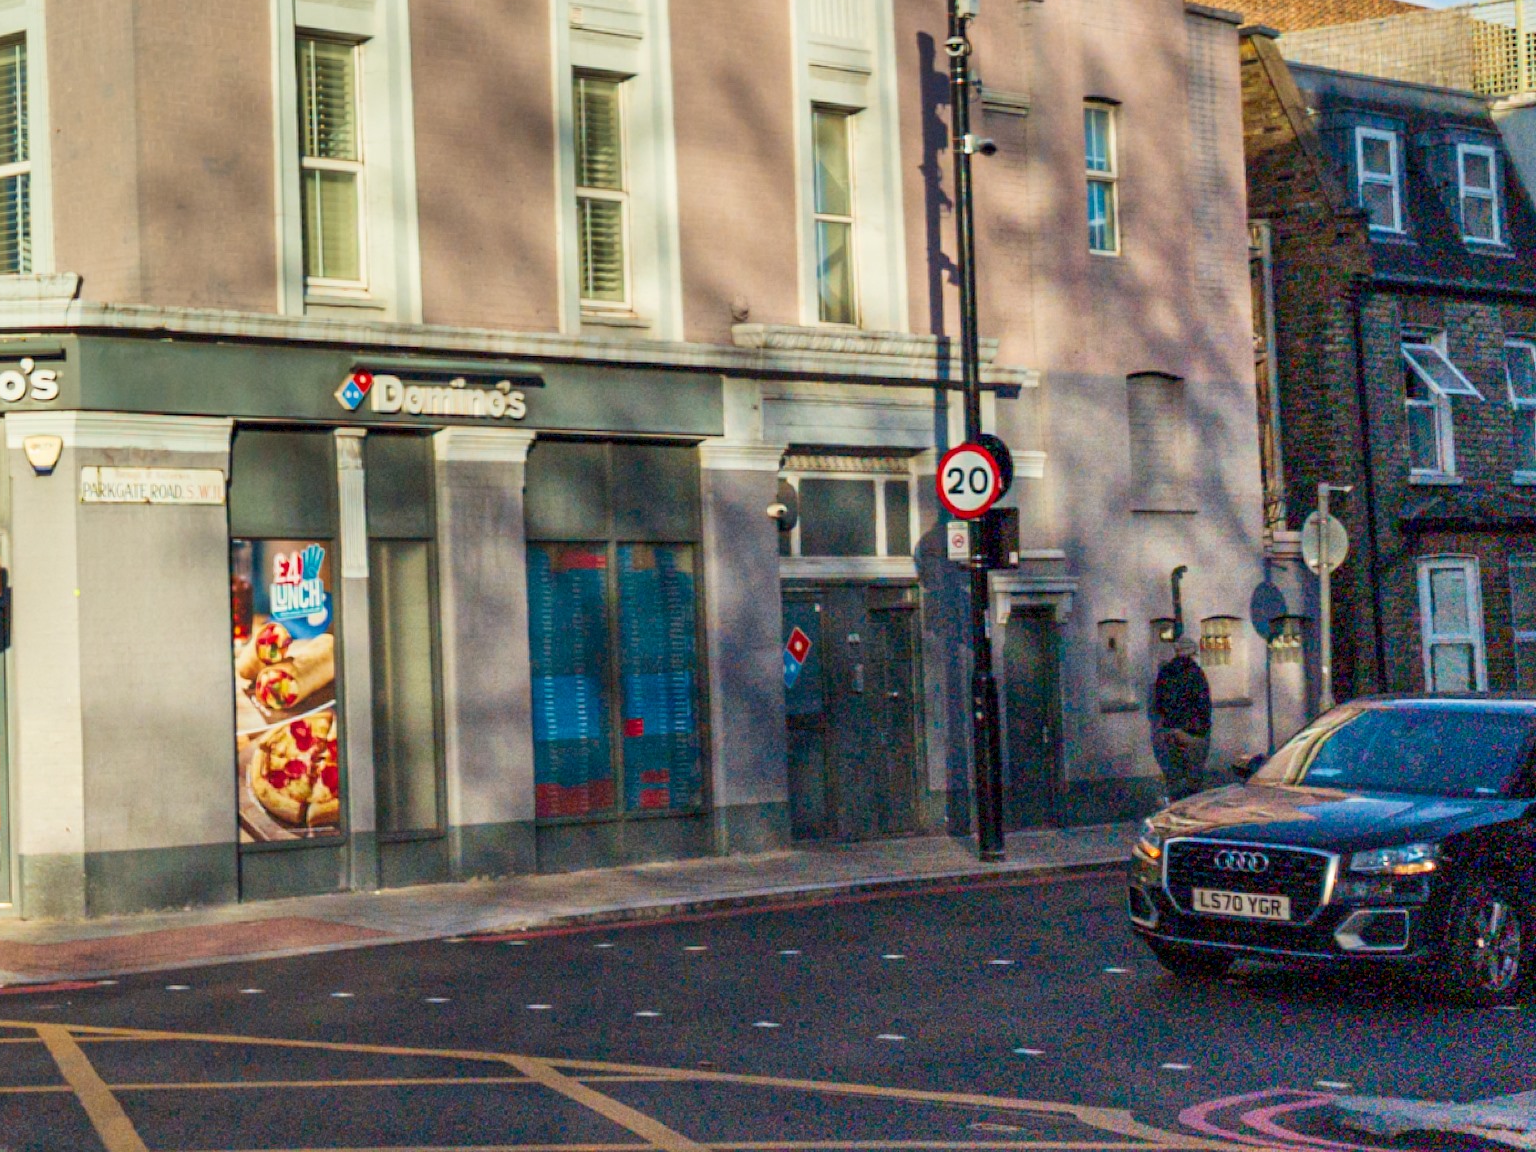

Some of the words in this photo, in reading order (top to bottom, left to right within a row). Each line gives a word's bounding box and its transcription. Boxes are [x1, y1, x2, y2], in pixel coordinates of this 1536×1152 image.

[371, 374, 526, 420] Domino's
[82, 481, 148, 499] PARKGATE
[947, 466, 988, 494] 20
[273, 551, 302, 586] £4
[269, 579, 321, 613] LUNCH
[1200, 891, 1243, 912] LS70
[1248, 896, 1281, 916] YGR
